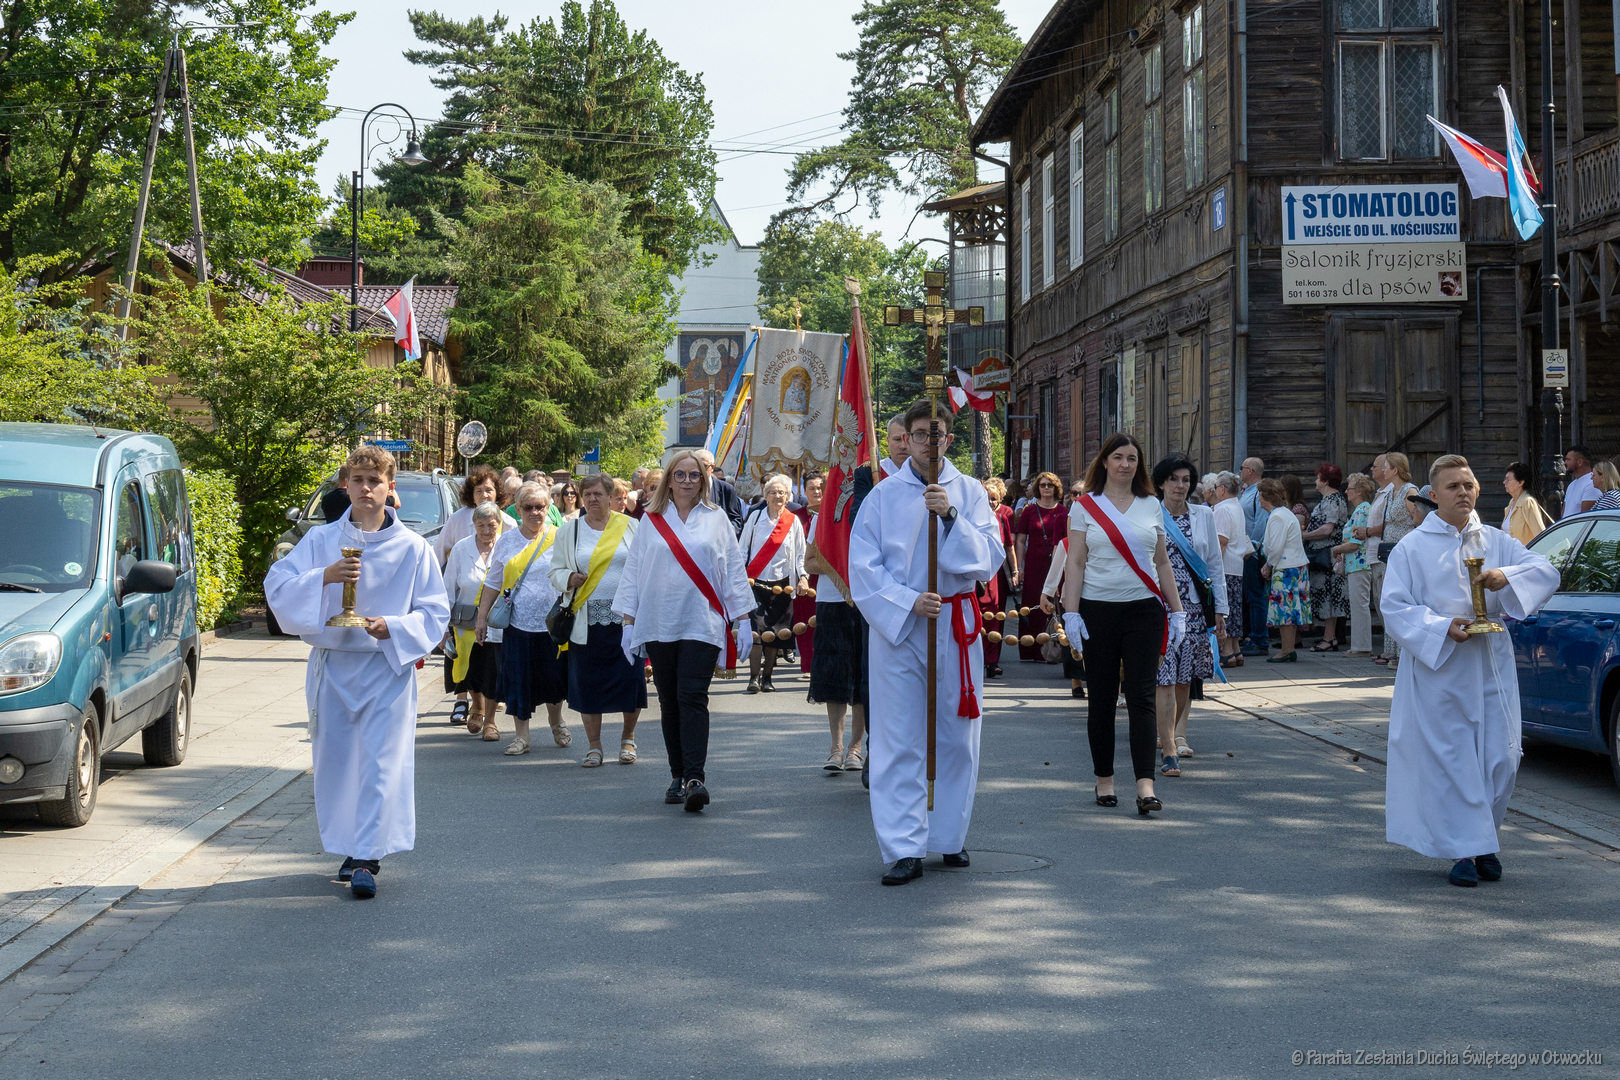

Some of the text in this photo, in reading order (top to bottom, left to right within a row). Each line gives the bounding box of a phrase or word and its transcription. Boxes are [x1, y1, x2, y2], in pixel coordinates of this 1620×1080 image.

[1302, 191, 1457, 219] STOMATOLOG
[1303, 221, 1457, 238] WEJŚCIE OD UL. KOŚCIUSZKI
[1285, 249, 1462, 272] Salonik fryzjerski
[1288, 289, 1338, 298] 501 160 378
[1295, 279, 1327, 287] tel.kom.
[1342, 277, 1432, 300] dla psów
[762, 360, 776, 386] MATKO
[769, 355, 823, 388] PATRONKO OTWOCKA
